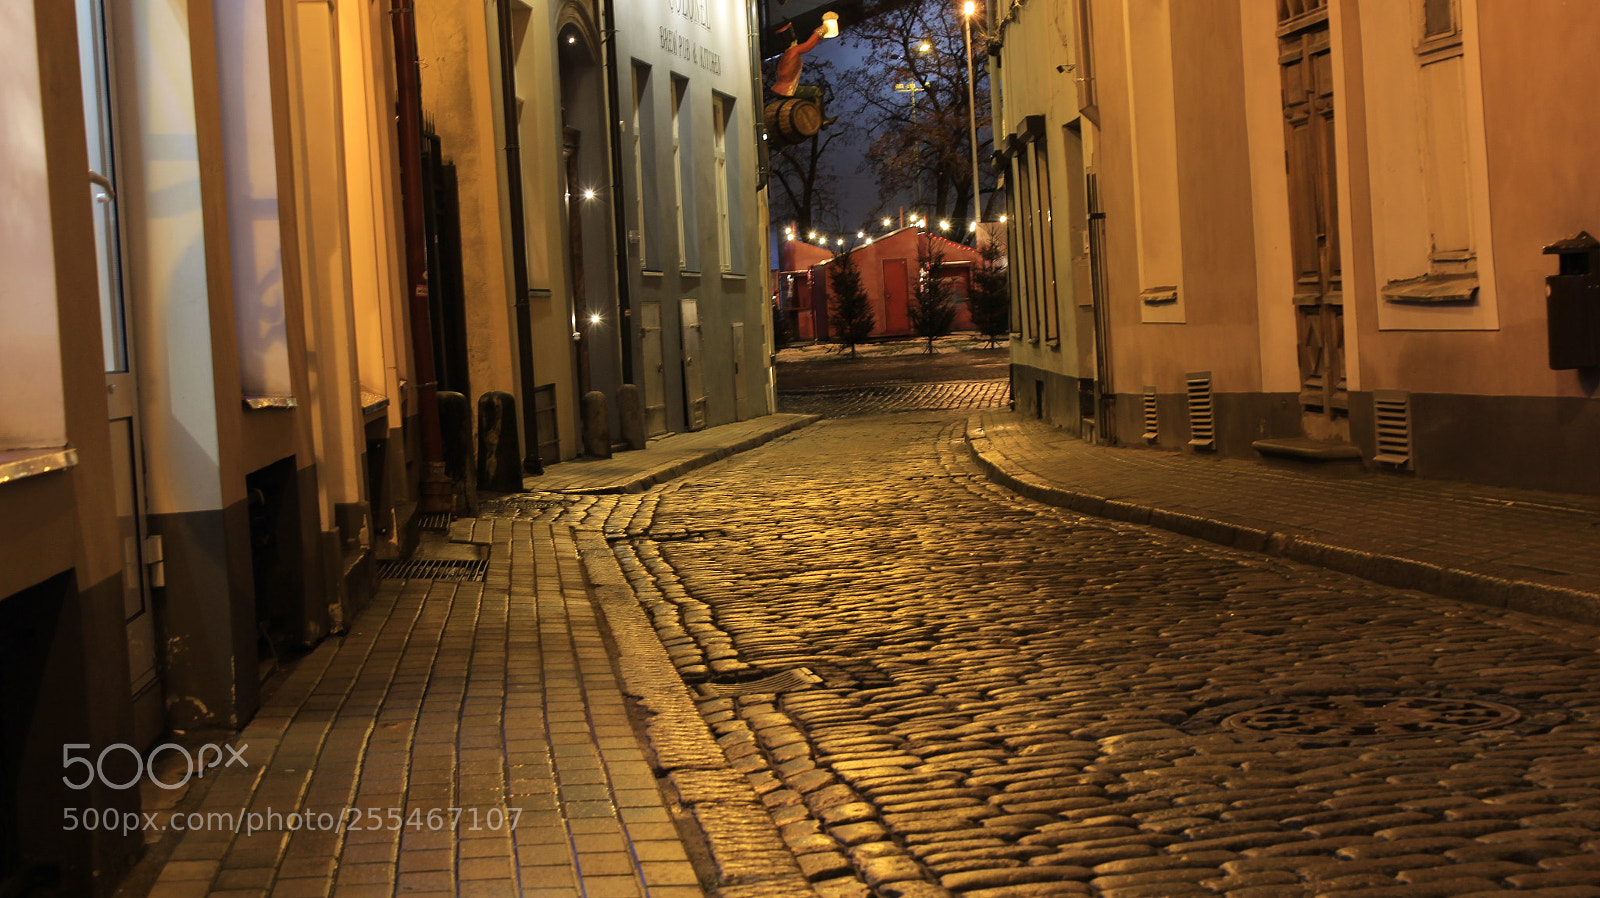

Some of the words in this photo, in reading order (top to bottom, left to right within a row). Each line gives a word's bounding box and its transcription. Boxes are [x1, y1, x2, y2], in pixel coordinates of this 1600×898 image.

[660, 25, 678, 56] BREW
[679, 34, 691, 62] PUB
[693, 42, 698, 65] &
[700, 45, 722, 76] KITCHEN
